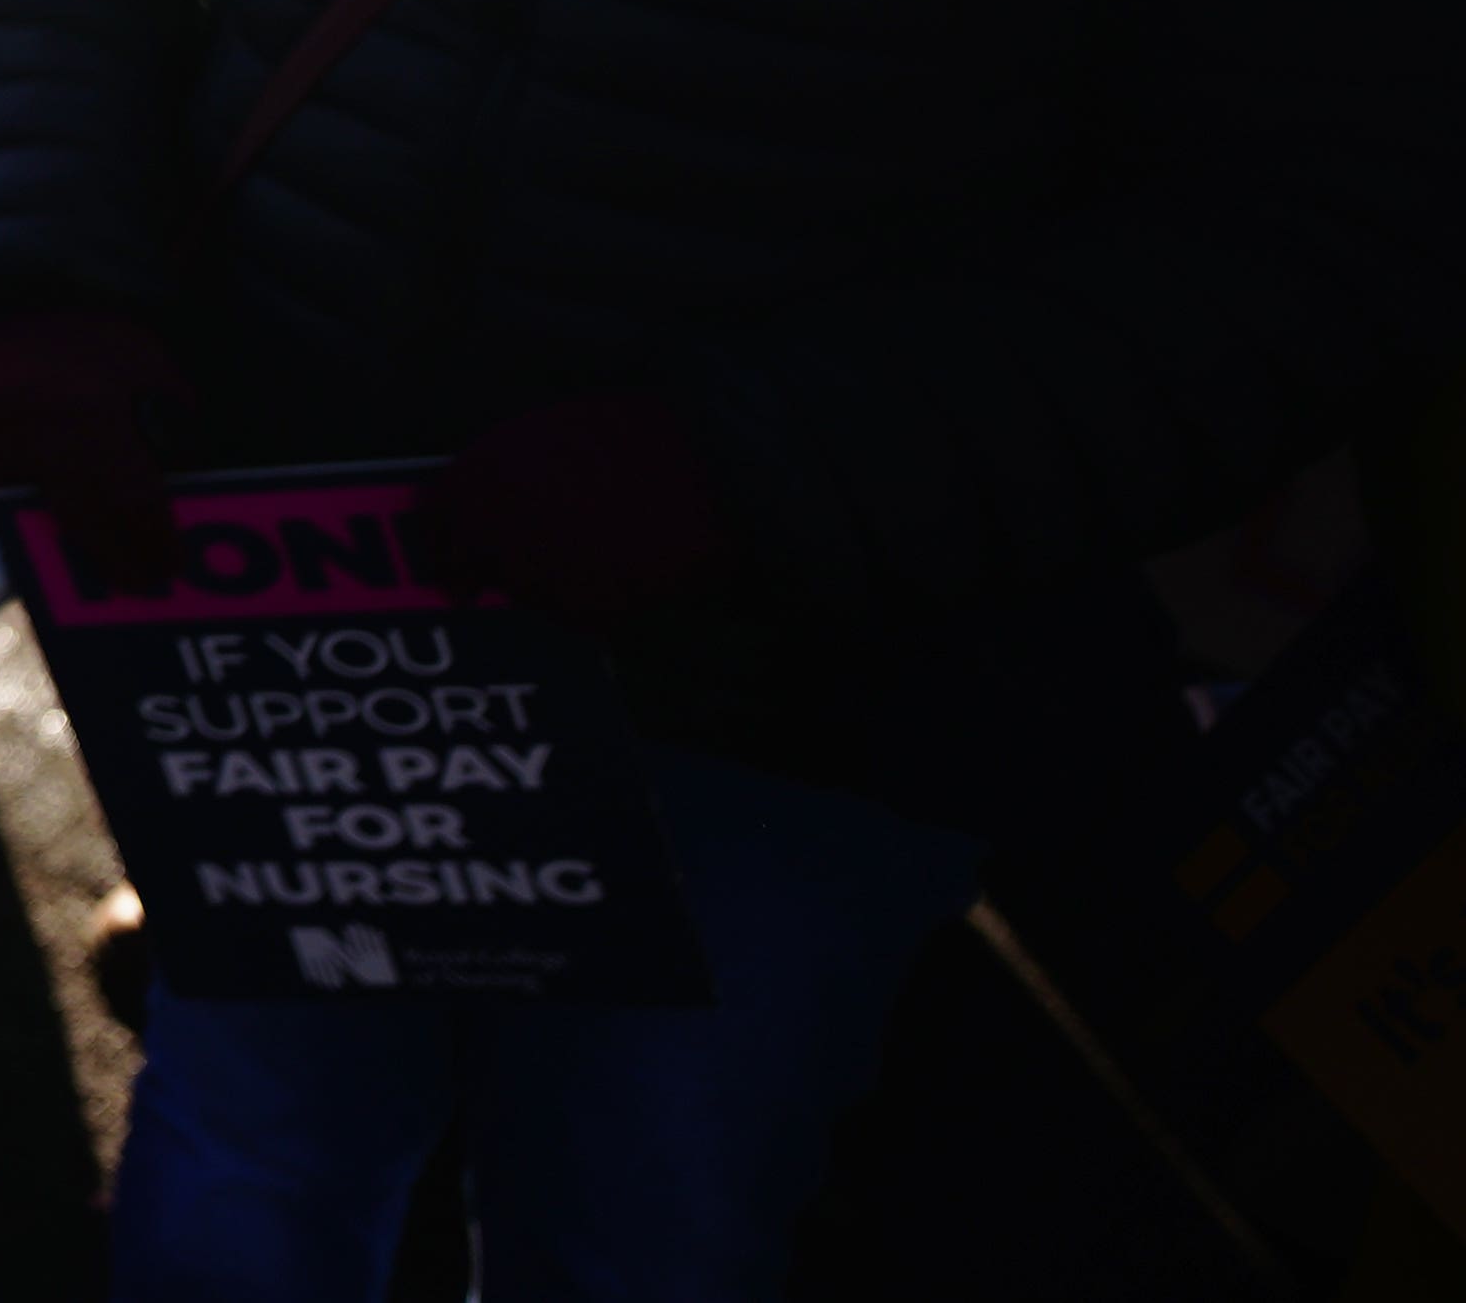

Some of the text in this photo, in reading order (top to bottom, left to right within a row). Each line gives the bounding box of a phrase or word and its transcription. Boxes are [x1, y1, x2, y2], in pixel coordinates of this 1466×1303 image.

[176, 625, 454, 684] IF YOU
[136, 683, 539, 742] SUPPORT
[159, 742, 554, 798] FAIR PAY
[1239, 736, 1336, 836] FAIR
[282, 801, 473, 851] FOR
[194, 858, 605, 907] NURSING
